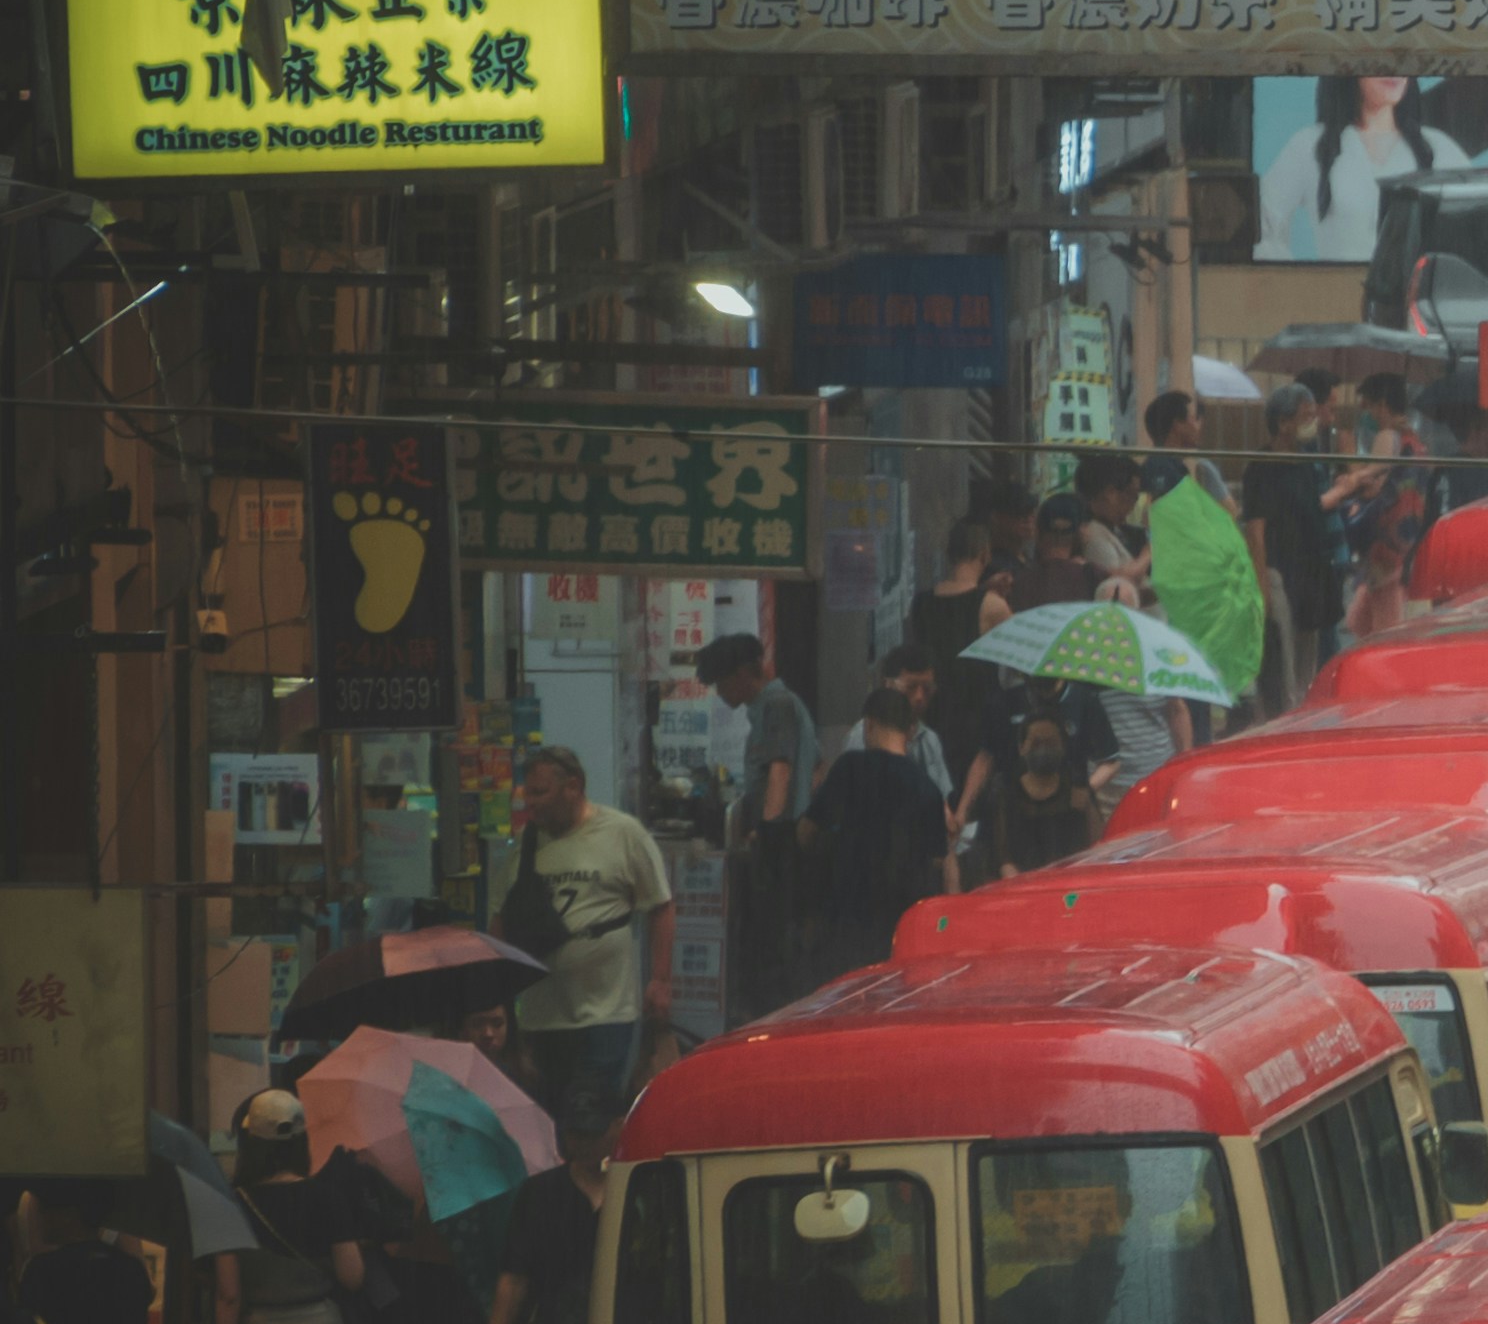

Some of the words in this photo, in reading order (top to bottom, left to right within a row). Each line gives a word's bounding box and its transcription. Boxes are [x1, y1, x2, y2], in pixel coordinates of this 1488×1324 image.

[135, 31, 538, 109] 四川麻辣米線
[136, 123, 261, 153] Chinese
[267, 121, 377, 149] Noodle
[384, 118, 543, 146] Resturant
[16, 973, 76, 1023] 線
